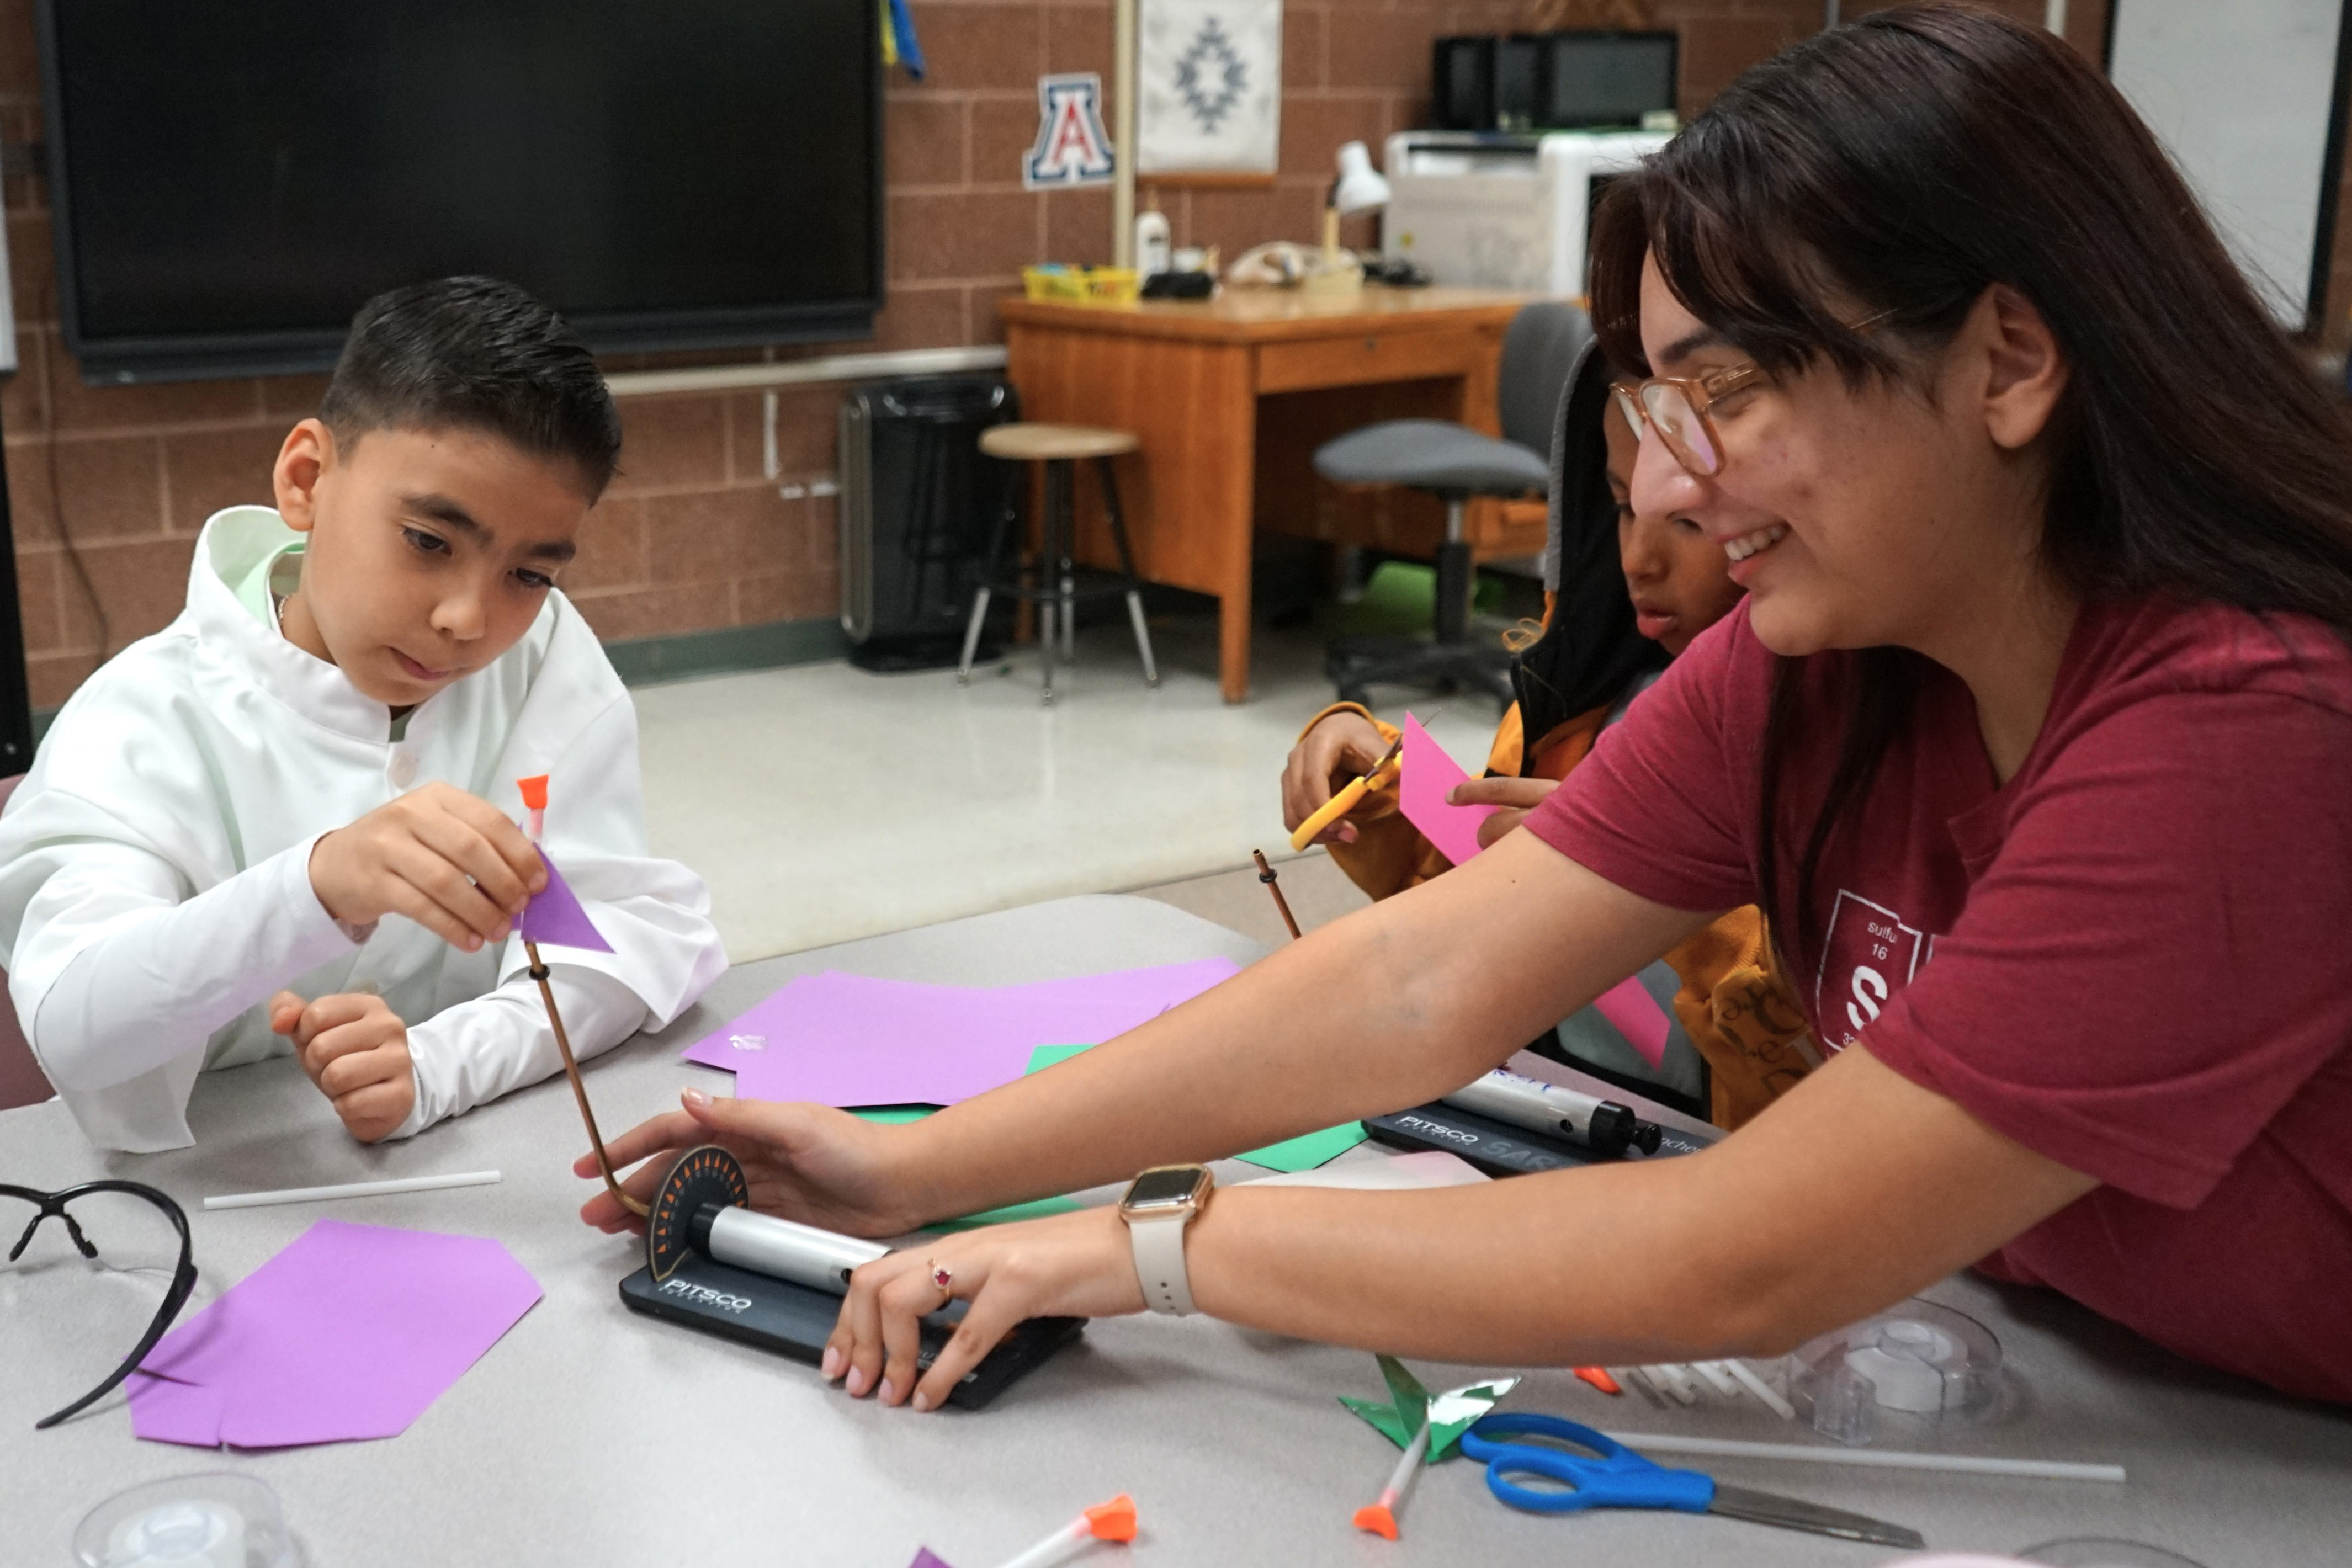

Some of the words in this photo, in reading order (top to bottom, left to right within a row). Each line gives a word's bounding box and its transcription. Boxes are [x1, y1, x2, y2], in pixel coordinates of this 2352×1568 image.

[1029, 79, 1115, 187] A
[1872, 943, 1888, 960] 16
[1847, 965, 1888, 1032] S
[1399, 1115, 1479, 1143] PITSCO
[664, 1279, 752, 1309] PITSCO
